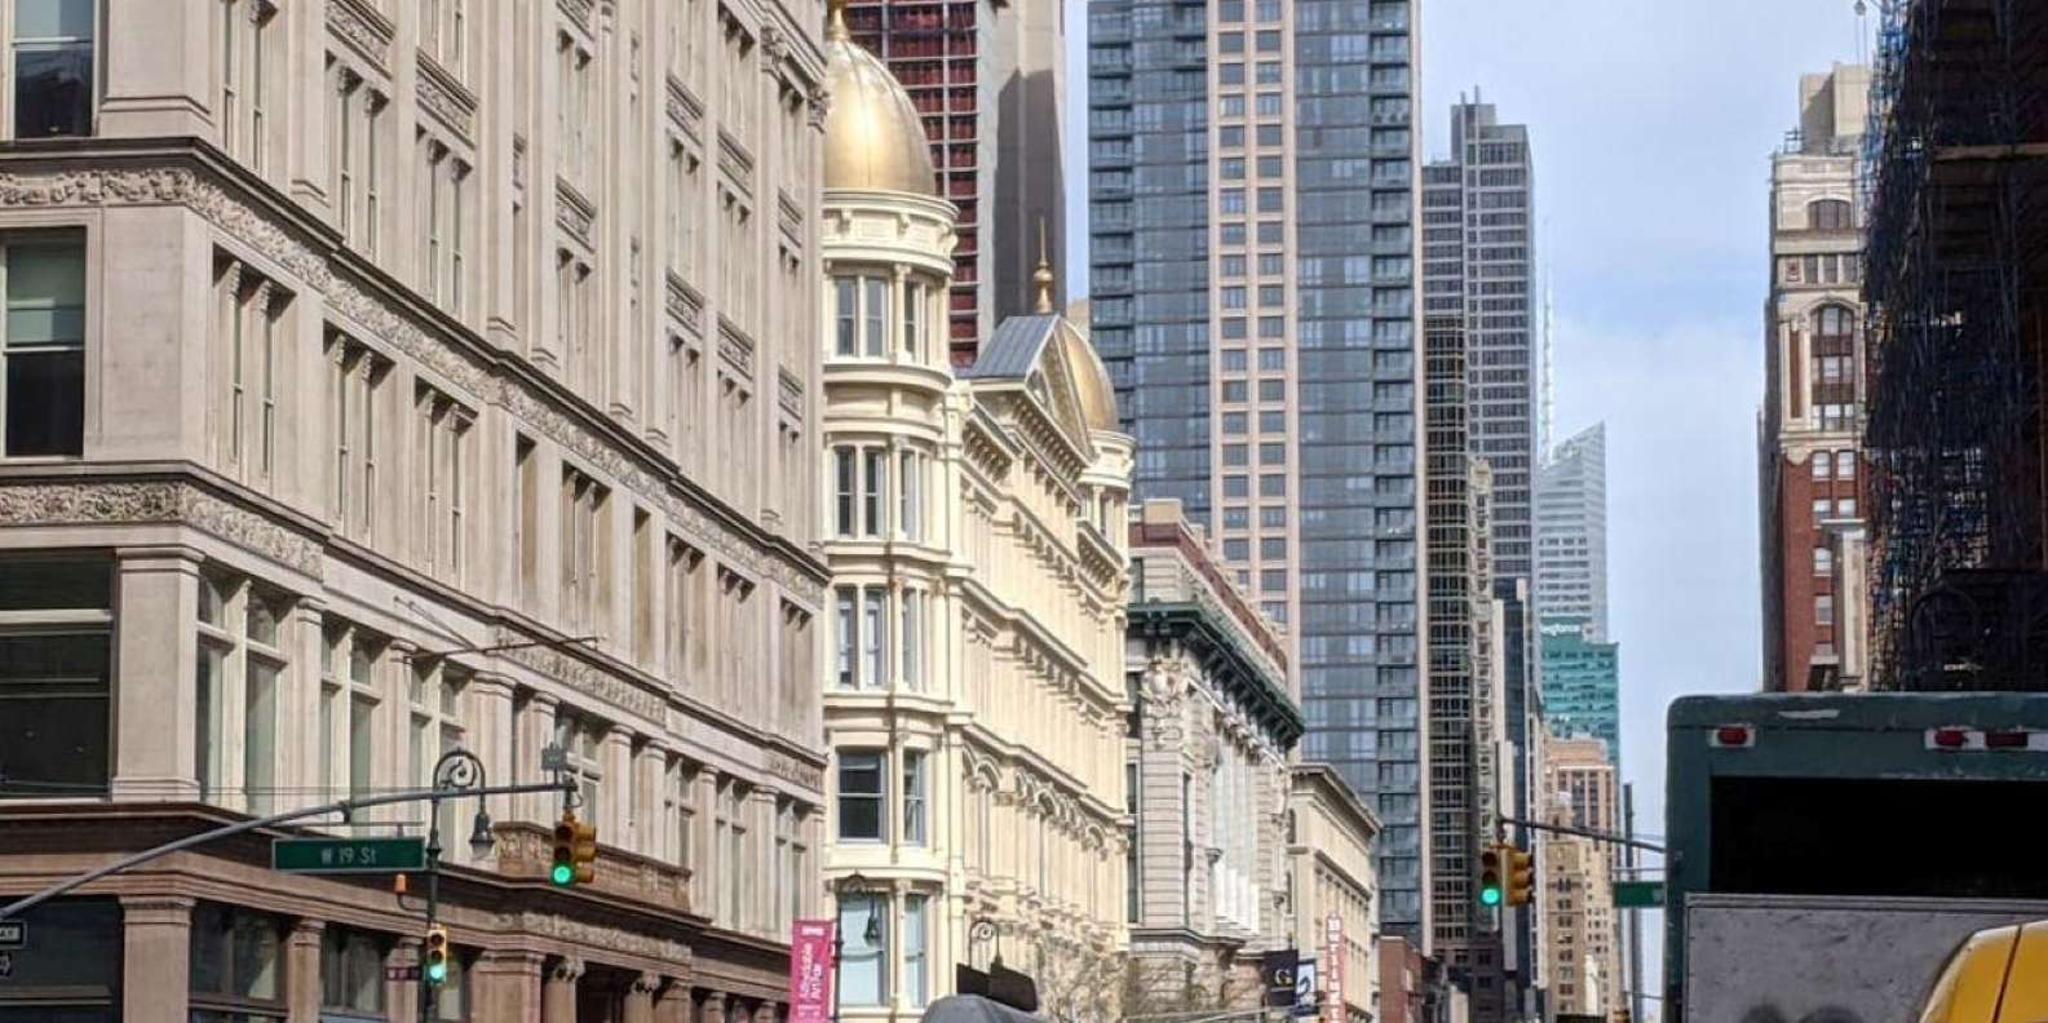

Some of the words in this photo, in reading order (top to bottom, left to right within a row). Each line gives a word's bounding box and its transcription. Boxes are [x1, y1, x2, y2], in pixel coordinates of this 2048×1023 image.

[321, 849, 332, 864] W
[339, 848, 353, 864] 19
[360, 847, 376, 864] St
[810, 983, 822, 999] Art
